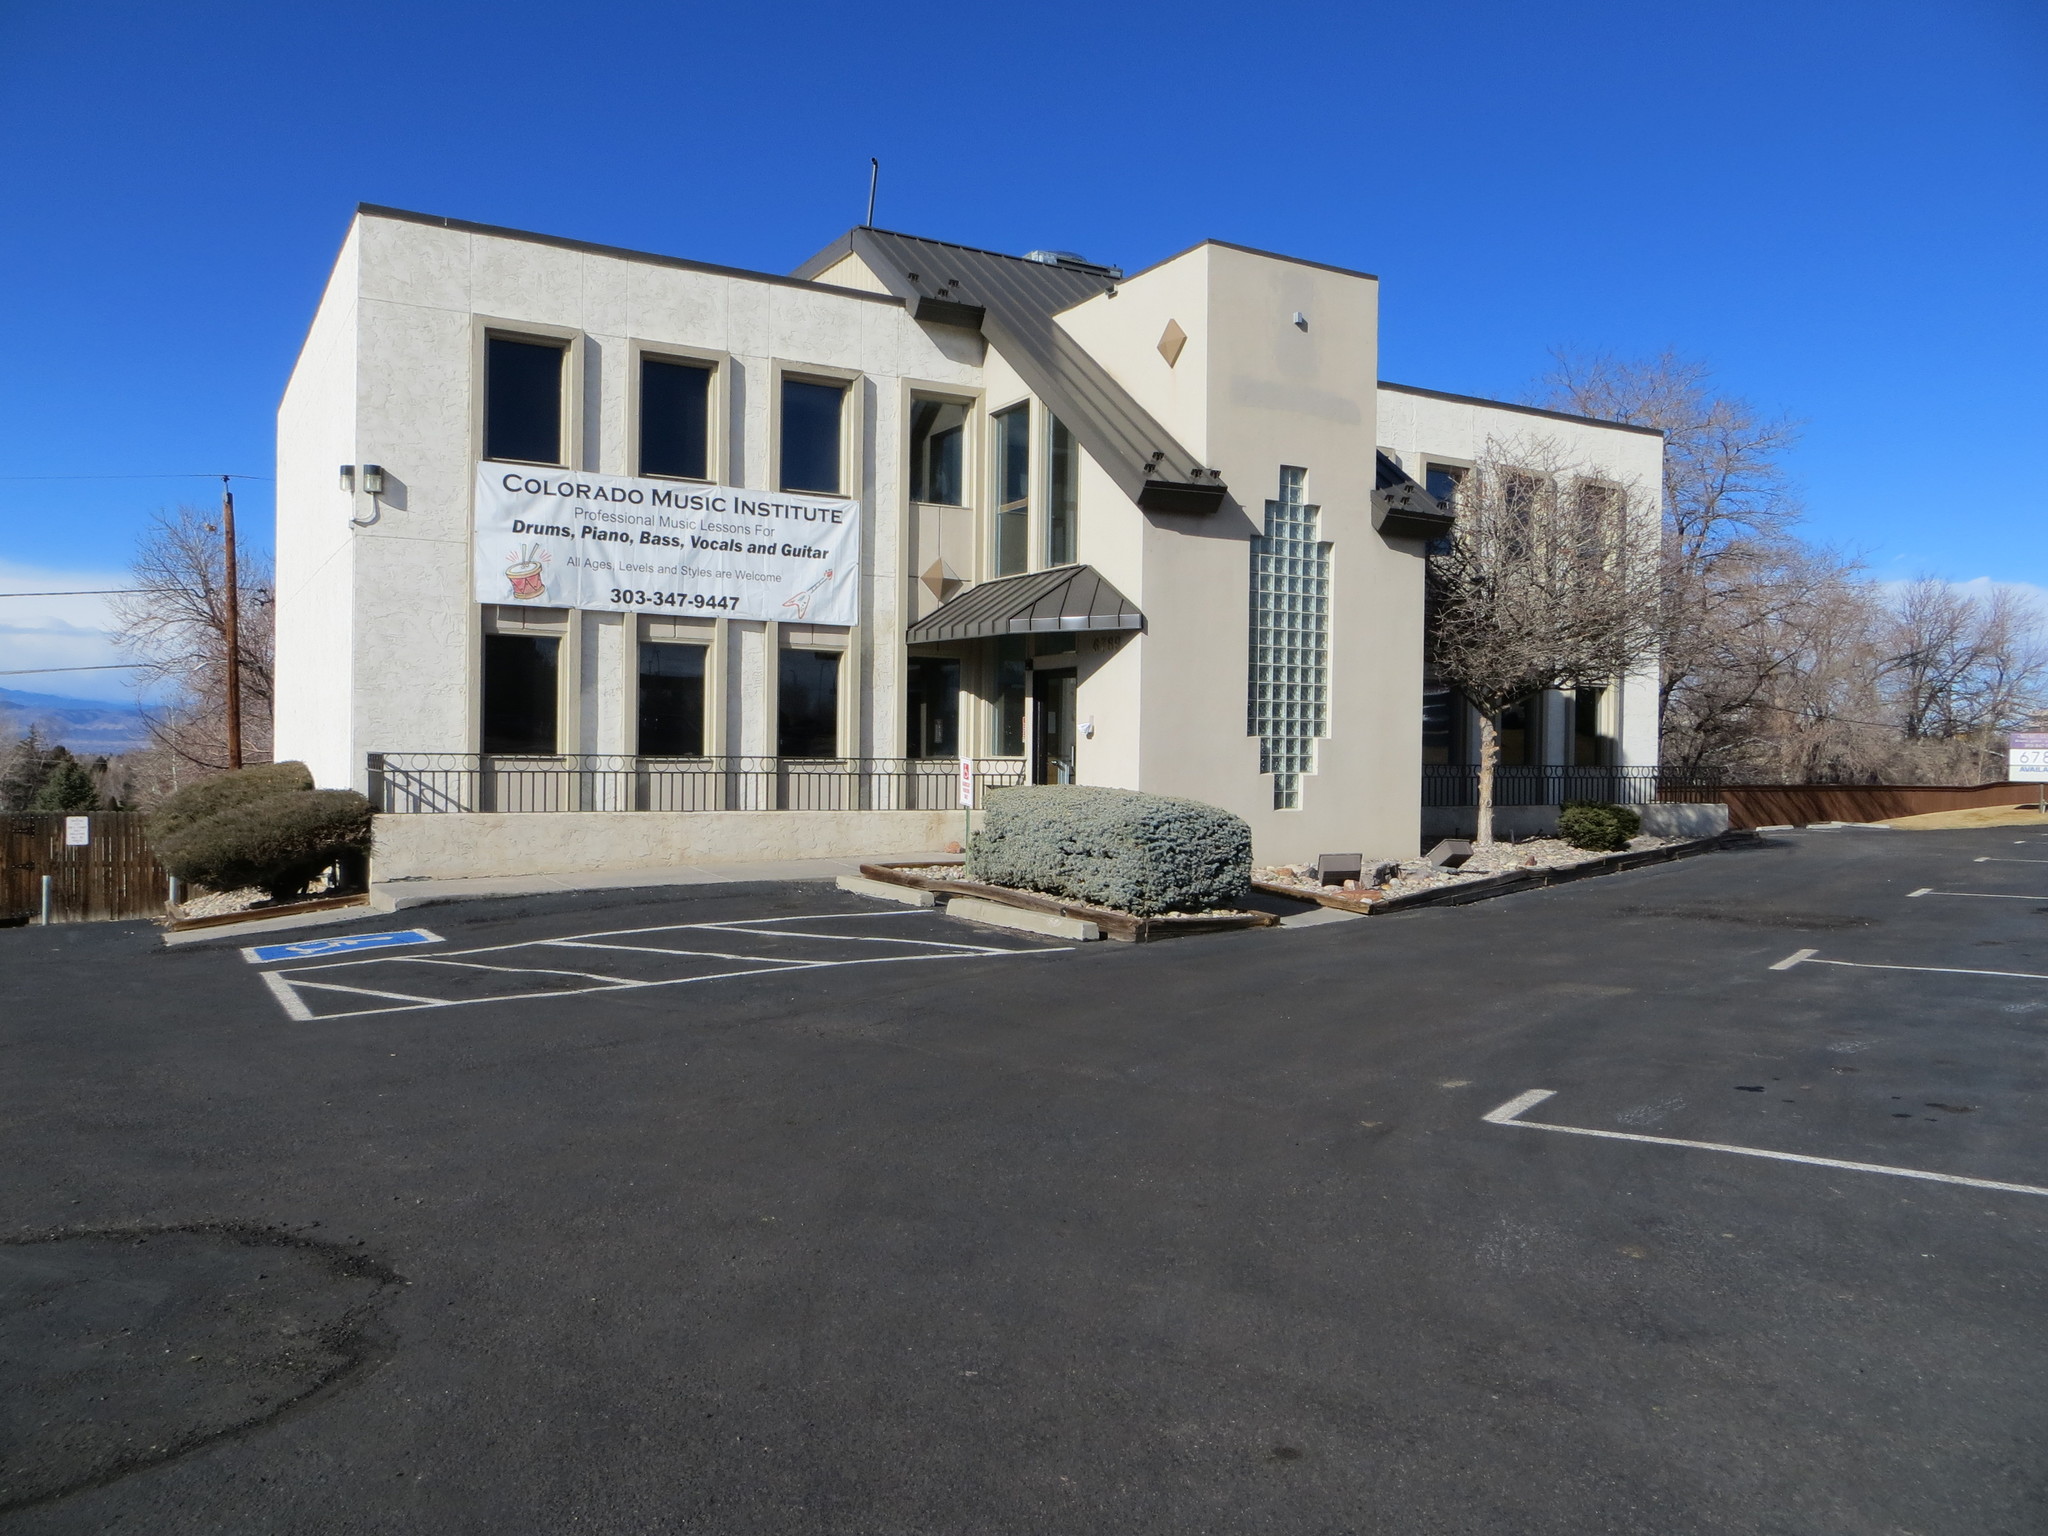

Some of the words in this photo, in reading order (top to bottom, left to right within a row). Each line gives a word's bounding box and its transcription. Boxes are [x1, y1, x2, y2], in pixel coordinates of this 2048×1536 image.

[502, 473, 644, 504] COLORADO
[651, 489, 725, 512] MUSIC
[735, 497, 843, 524] INSTITUTE
[574, 507, 655, 526] Professional
[659, 515, 696, 530] Music
[700, 519, 750, 534] Lessons
[754, 525, 776, 537] For
[512, 519, 576, 539] Drums,
[581, 525, 634, 546] Piano,
[639, 531, 685, 550] Bass,
[690, 535, 743, 552] Vocals
[747, 543, 777, 555] and
[782, 544, 830, 560] Guitar
[566, 556, 580, 567] All
[584, 558, 615, 571] Ages,
[619, 563, 653, 574] Levels
[657, 565, 678, 576] and
[680, 565, 712, 579] Styles
[715, 570, 732, 579] are
[735, 570, 782, 583] Welcome
[611, 588, 740, 611] 303-347-9447
